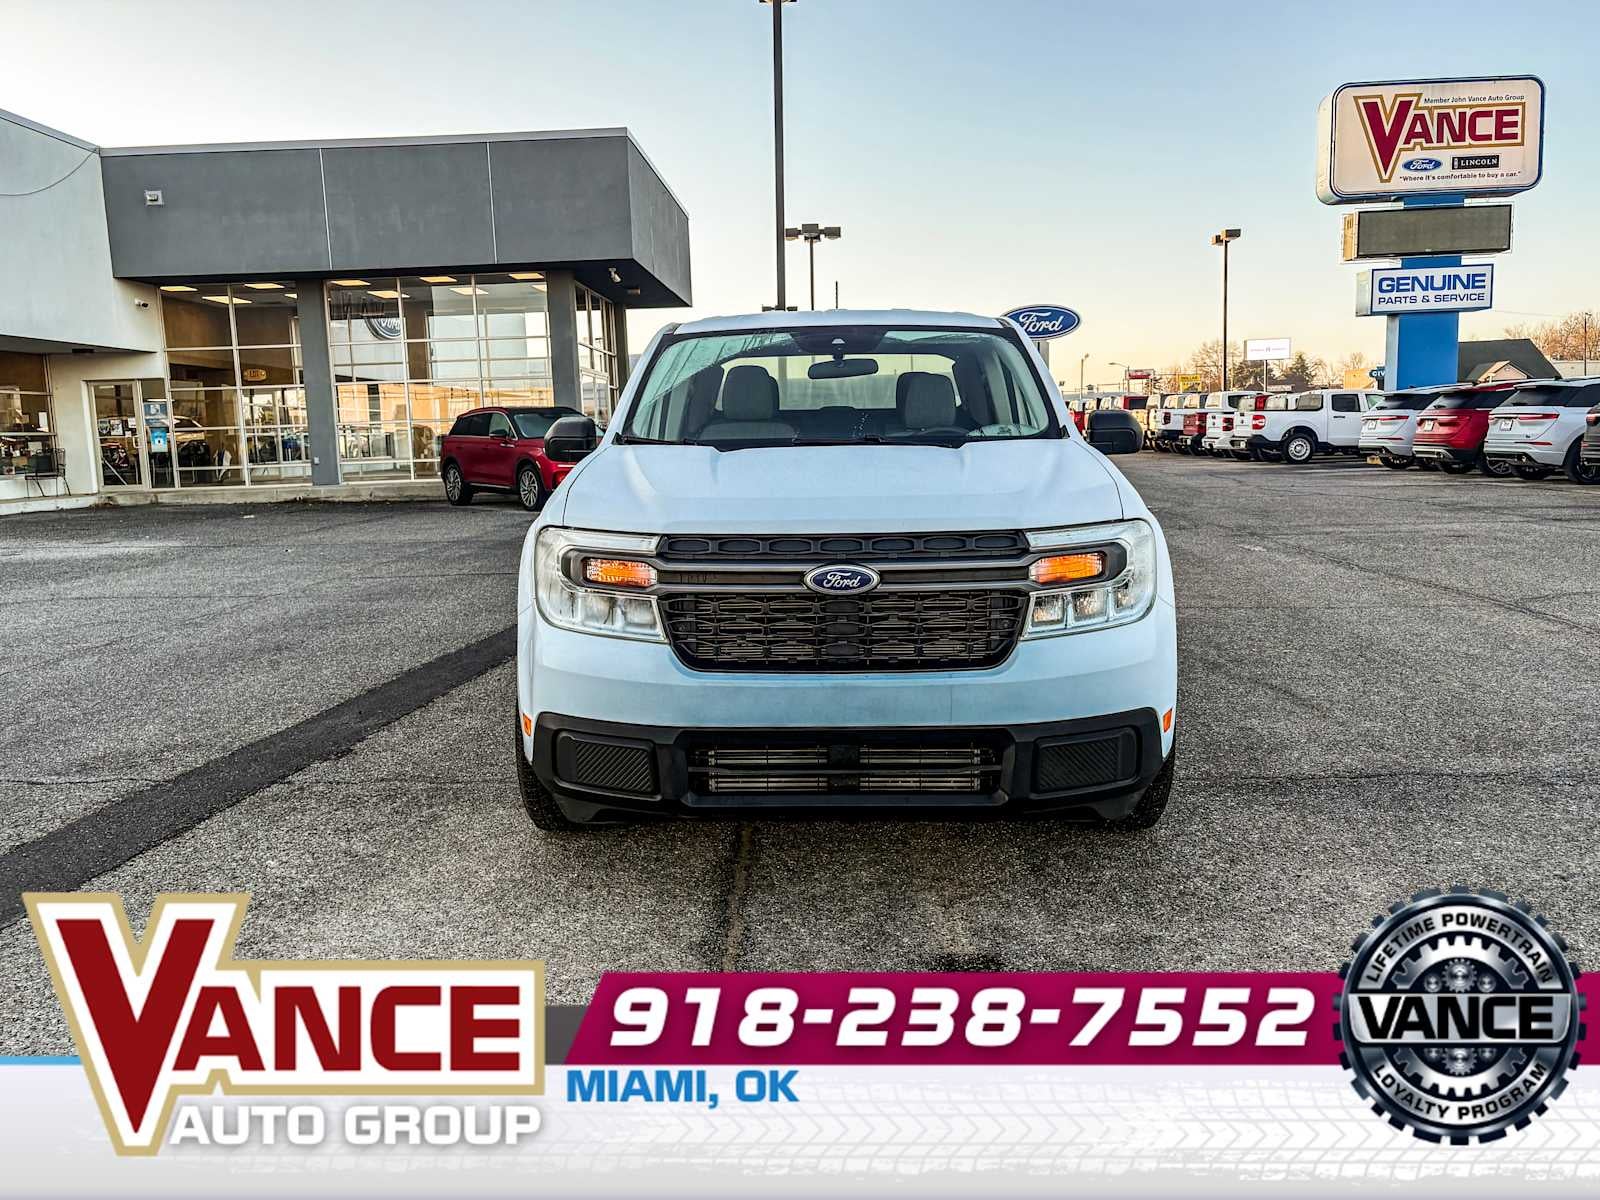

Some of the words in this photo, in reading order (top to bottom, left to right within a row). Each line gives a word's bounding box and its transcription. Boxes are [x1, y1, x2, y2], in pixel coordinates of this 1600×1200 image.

[1468, 95, 1487, 103] Vance
[1504, 94, 1525, 102] Group
[1362, 100, 1520, 176] VANCE
[1460, 157, 1498, 167] LINCOLN
[1425, 173, 1436, 181] it's
[1437, 171, 1477, 180] comfortable
[1487, 171, 1499, 179] buy
[1378, 273, 1486, 293] GENUINE
[1378, 295, 1417, 304] PARTS
[1421, 295, 1430, 303] &
[1434, 292, 1485, 303] SERVICE
[1018, 311, 1065, 332] Ford
[823, 571, 861, 588] Ford
